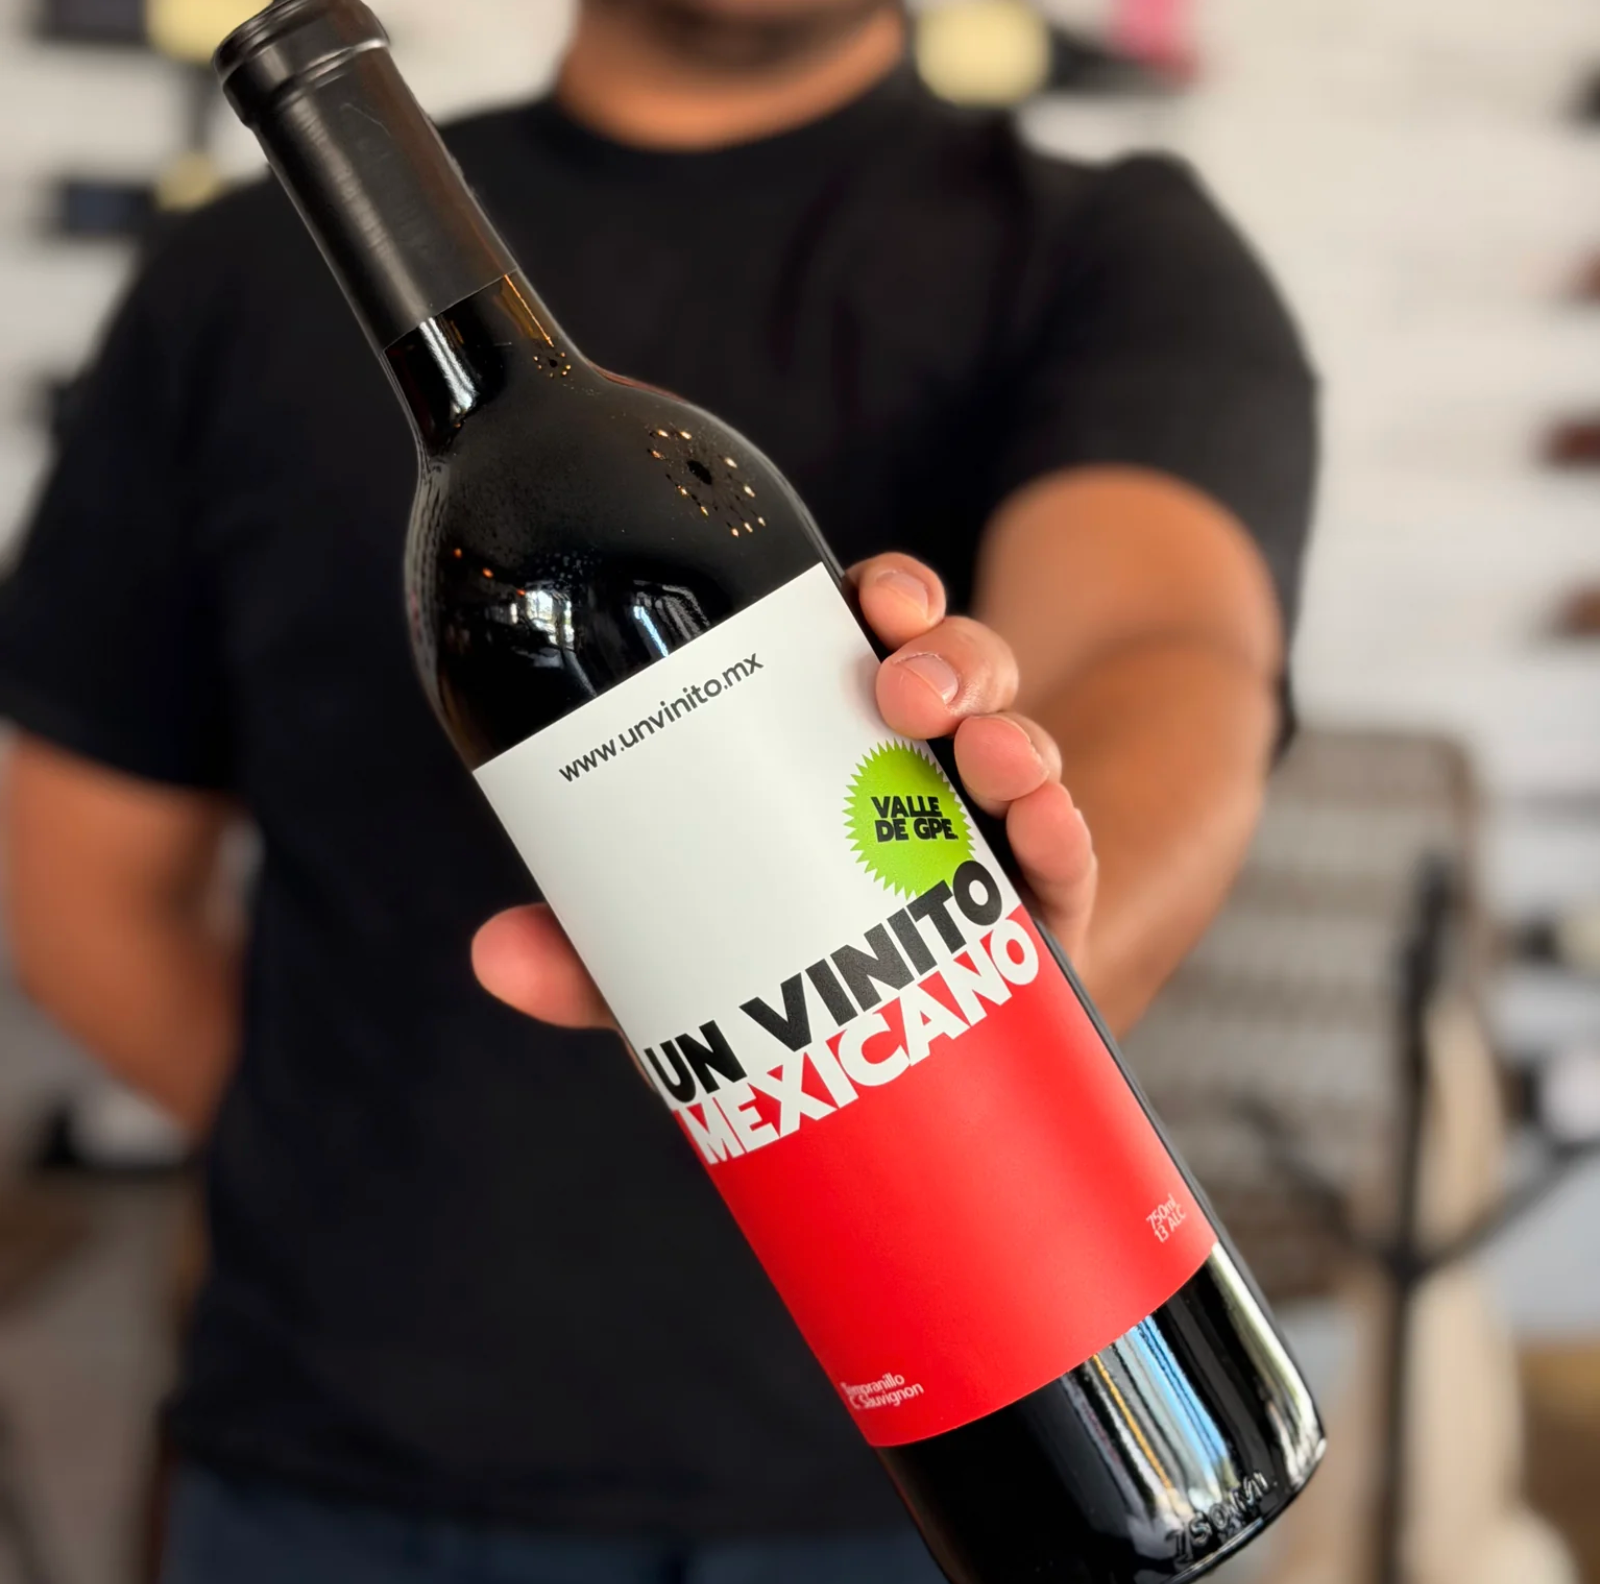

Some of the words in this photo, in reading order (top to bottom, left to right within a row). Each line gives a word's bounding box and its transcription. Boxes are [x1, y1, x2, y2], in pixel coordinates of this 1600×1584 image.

[559, 653, 764, 782] www.unvinito.mx
[871, 795, 943, 819] VALLE
[875, 819, 909, 843] DE
[643, 1019, 748, 1103] UN
[739, 860, 1003, 1052] VINITO
[677, 919, 1039, 1166] MEXICANO
[1145, 1193, 1177, 1230] 750ml
[1154, 1224, 1169, 1243] 13
[1167, 1203, 1186, 1233] ALC
